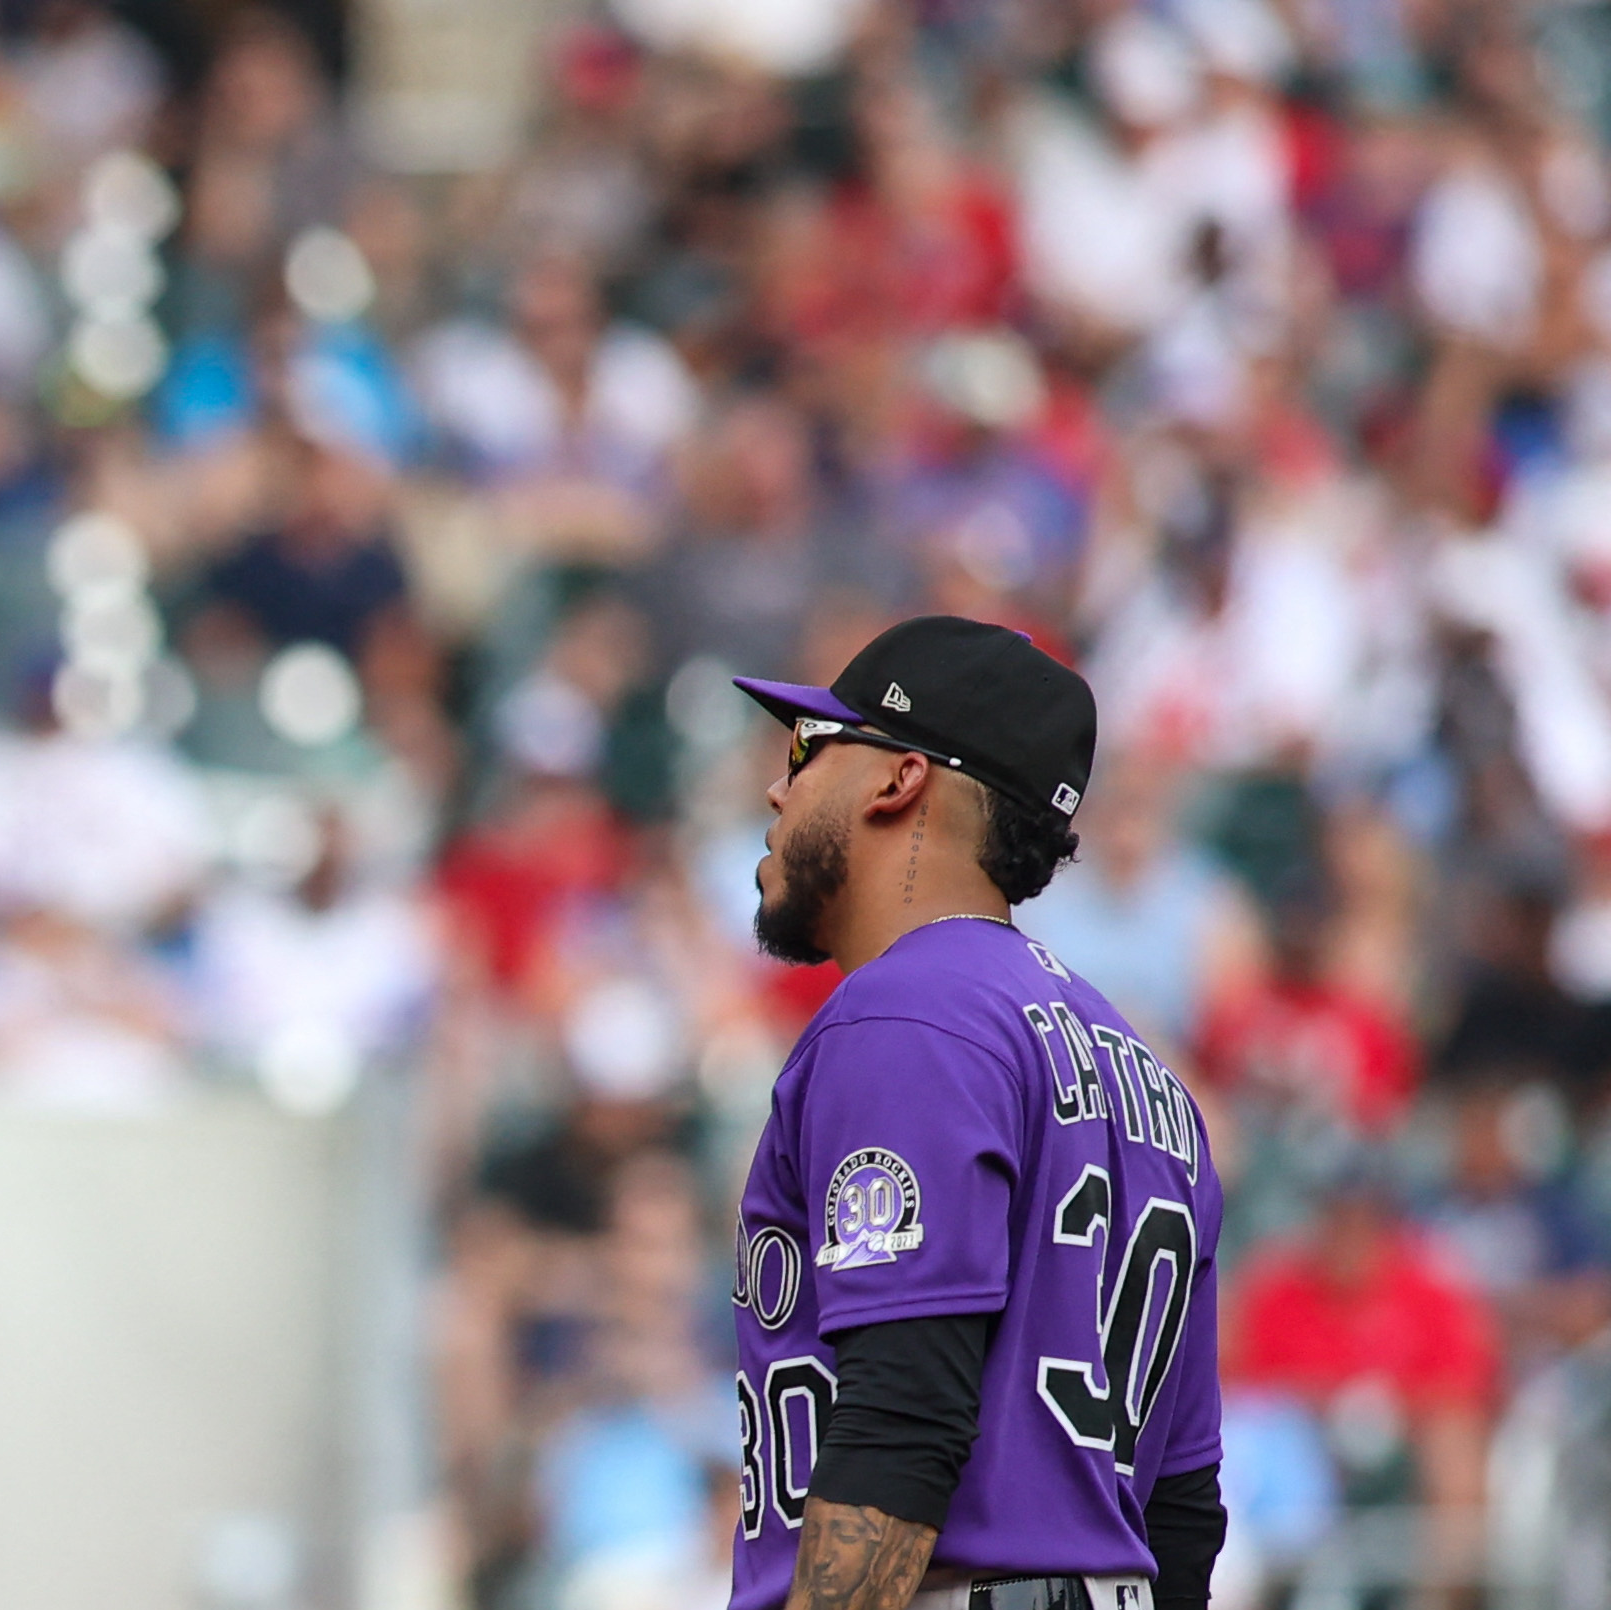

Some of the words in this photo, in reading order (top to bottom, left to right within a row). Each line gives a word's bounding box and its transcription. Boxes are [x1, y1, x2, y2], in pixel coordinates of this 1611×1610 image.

[1022, 1001, 1198, 1187] CATRO
[827, 1153, 868, 1227] COLORADO
[874, 1152, 916, 1209] ROCKIES
[840, 1176, 894, 1235] 30
[736, 1355, 839, 1541] 30
